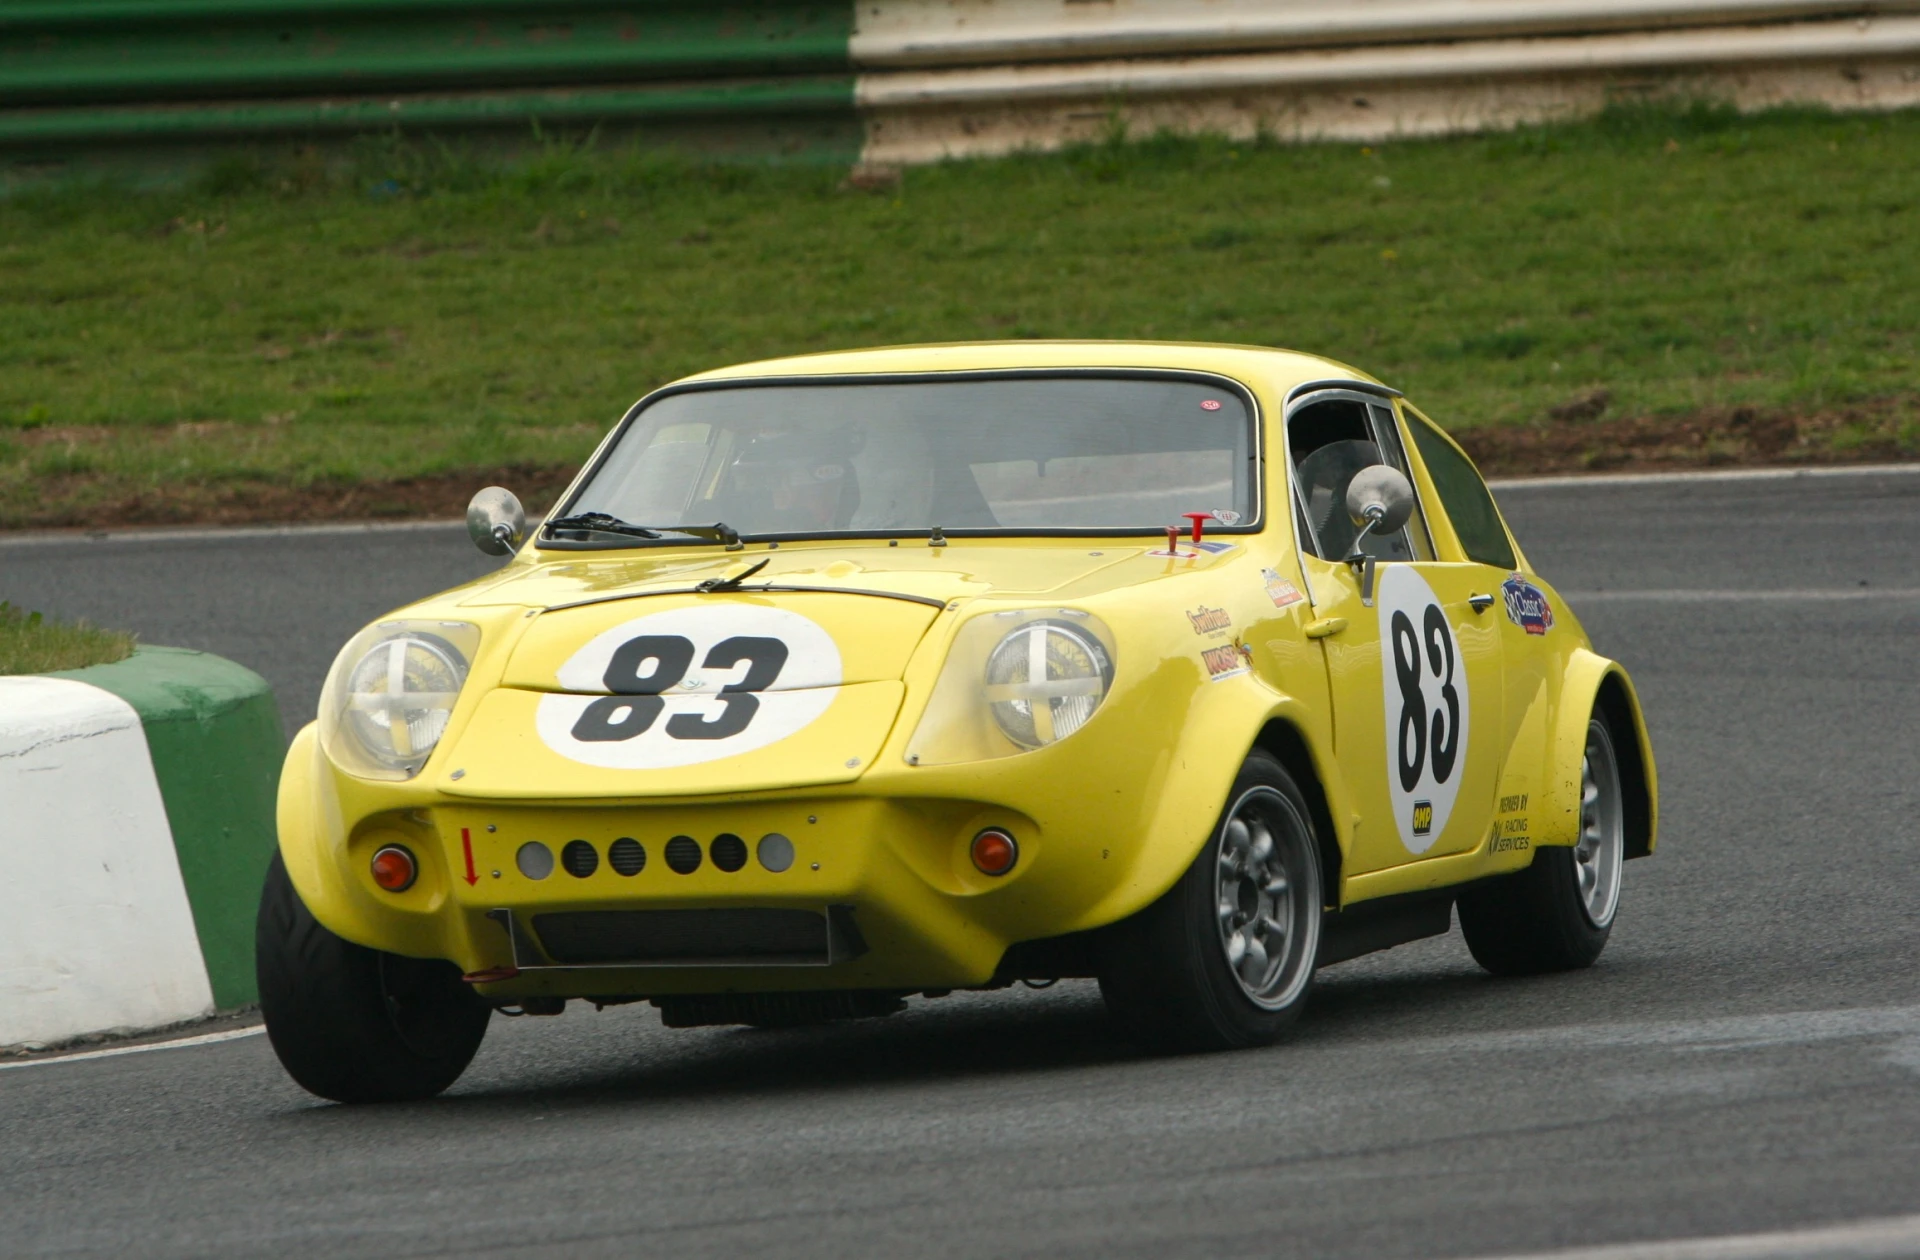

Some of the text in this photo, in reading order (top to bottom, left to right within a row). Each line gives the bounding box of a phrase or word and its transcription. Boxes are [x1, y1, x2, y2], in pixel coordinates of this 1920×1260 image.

[571, 635, 789, 742] 83
[1392, 603, 1459, 793] 83
[1414, 806, 1431, 830] OMP
[1505, 818, 1528, 833] RACING
[1498, 836, 1530, 852] SERVICES
